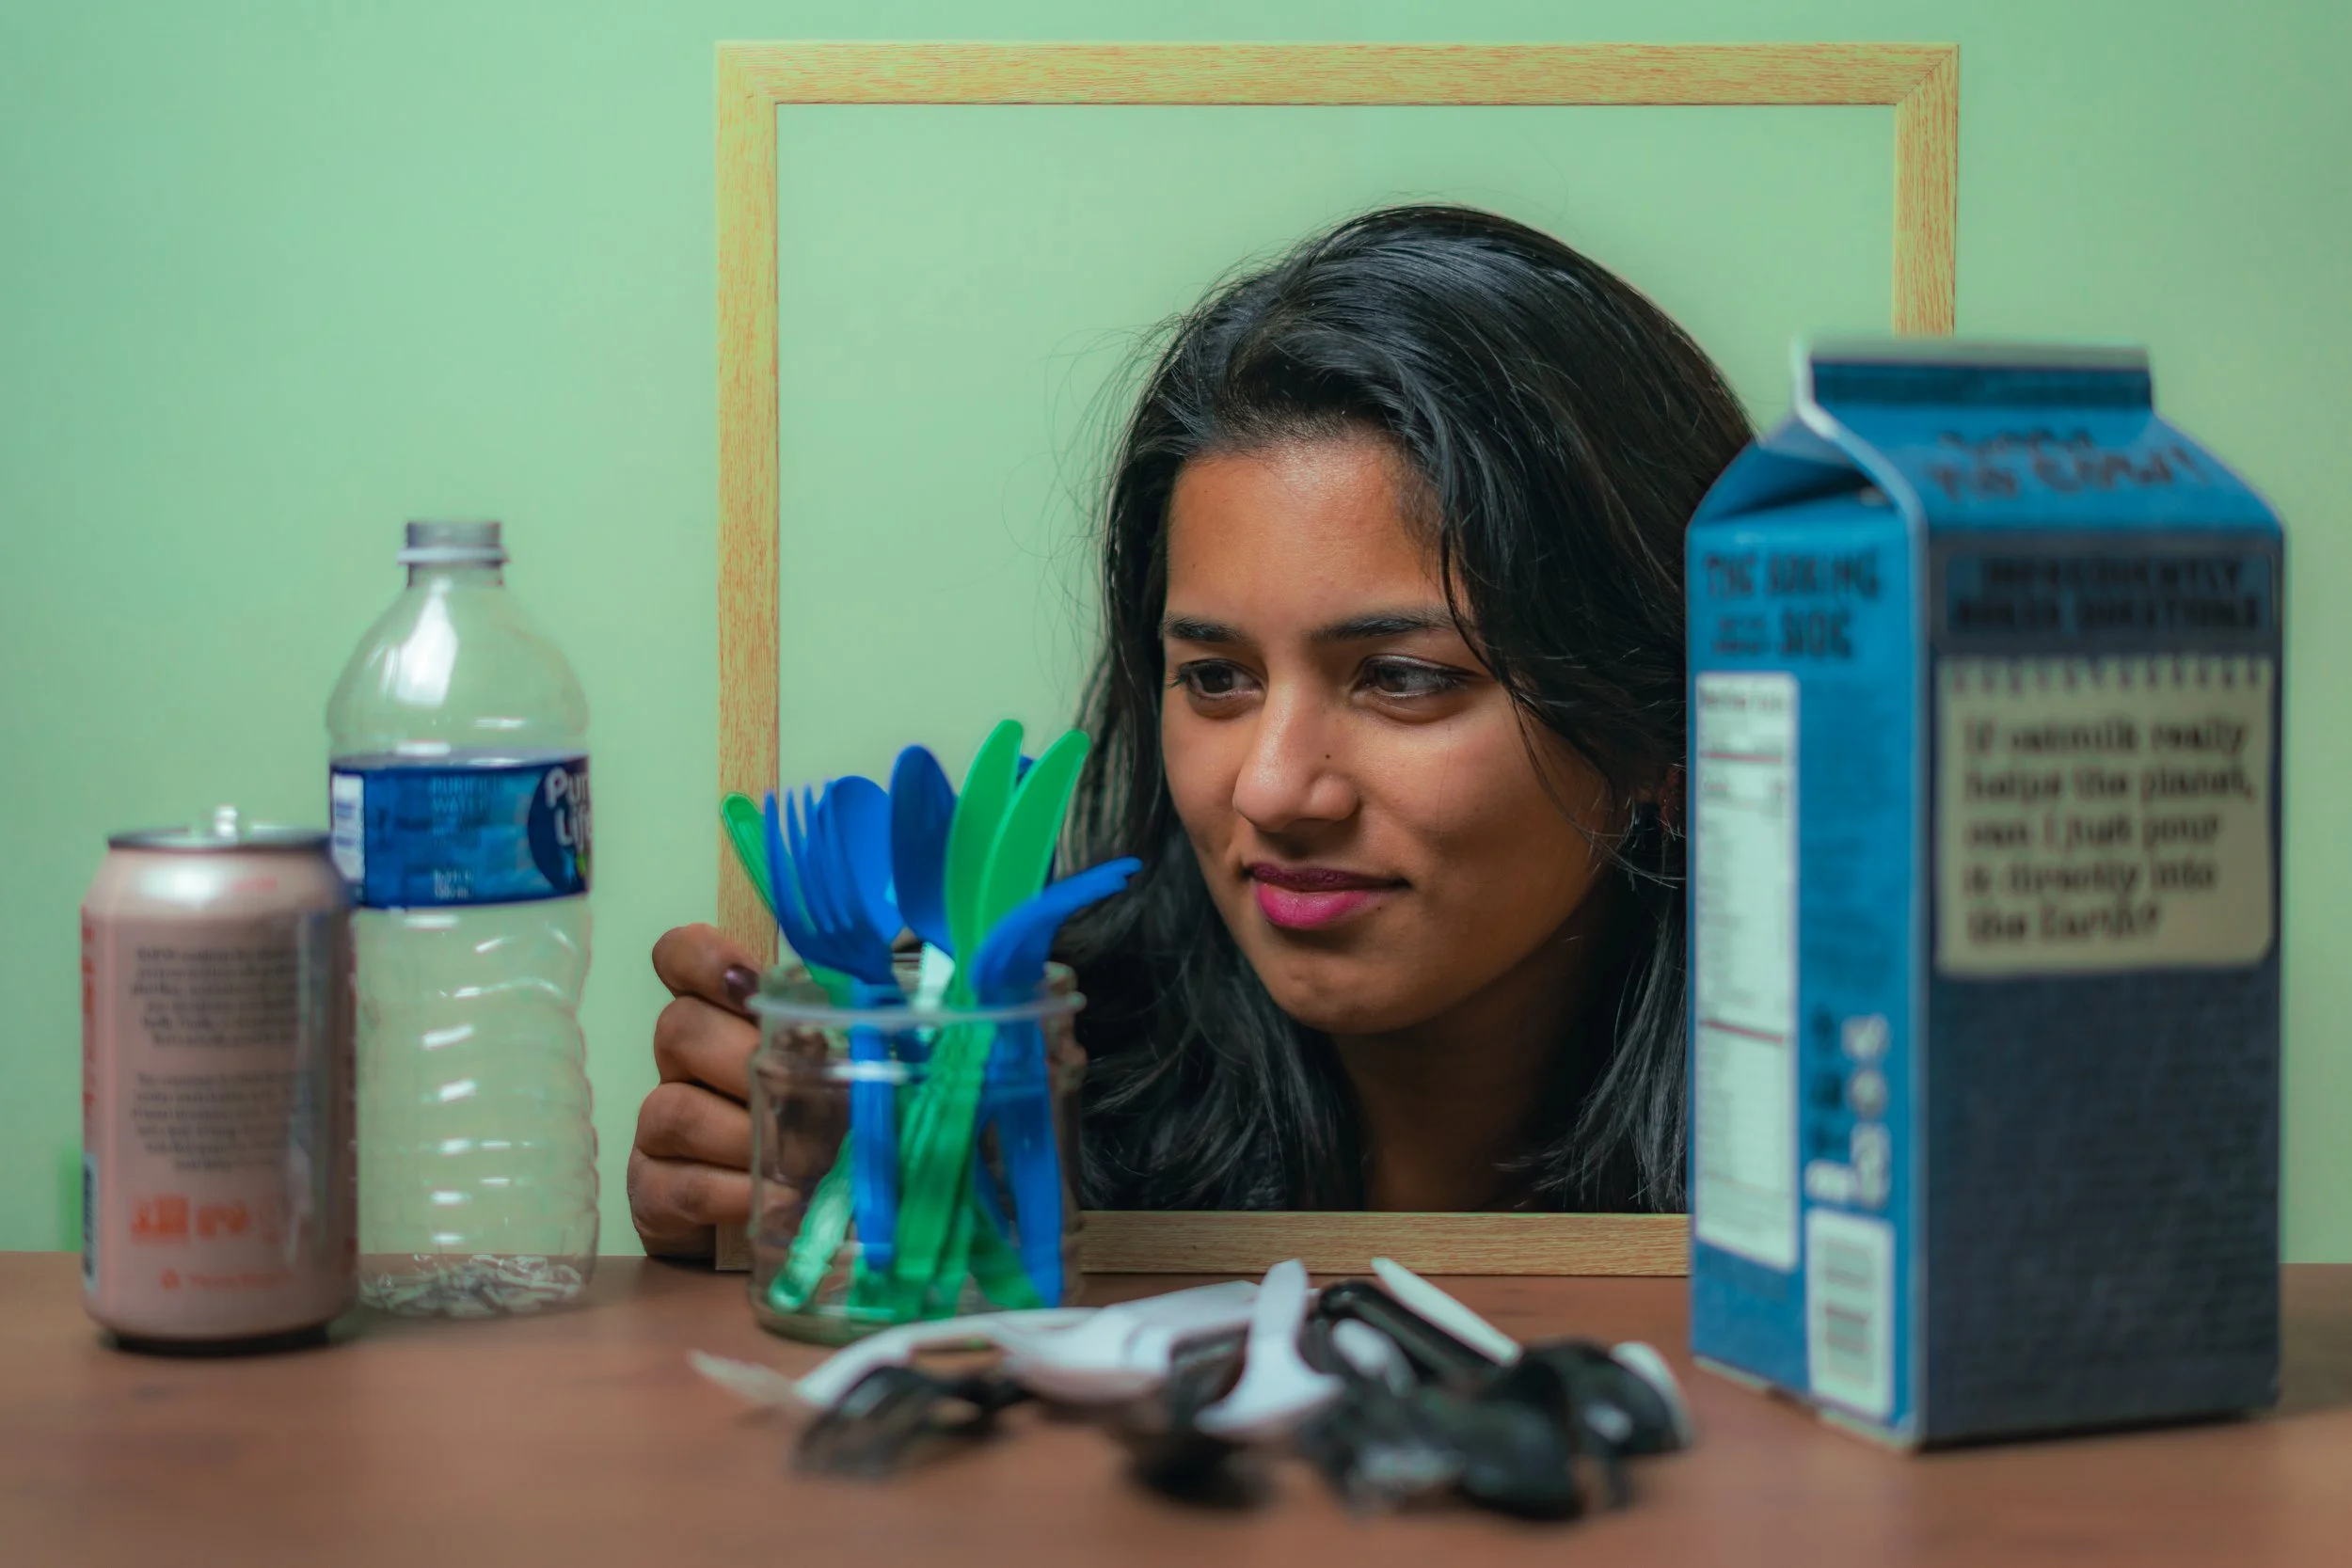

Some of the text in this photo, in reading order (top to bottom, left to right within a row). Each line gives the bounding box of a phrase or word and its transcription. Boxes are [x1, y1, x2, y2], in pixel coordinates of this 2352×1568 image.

[2152, 718, 2249, 756] really
[1965, 766, 2256, 804] helps the planet,
[1965, 818, 2030, 846] can
[2064, 816, 2132, 852] just
[2143, 814, 2220, 850] pour
[2005, 863, 2141, 895] directly
[2152, 860, 2218, 889] into
[1968, 903, 2160, 942] the Earth?
